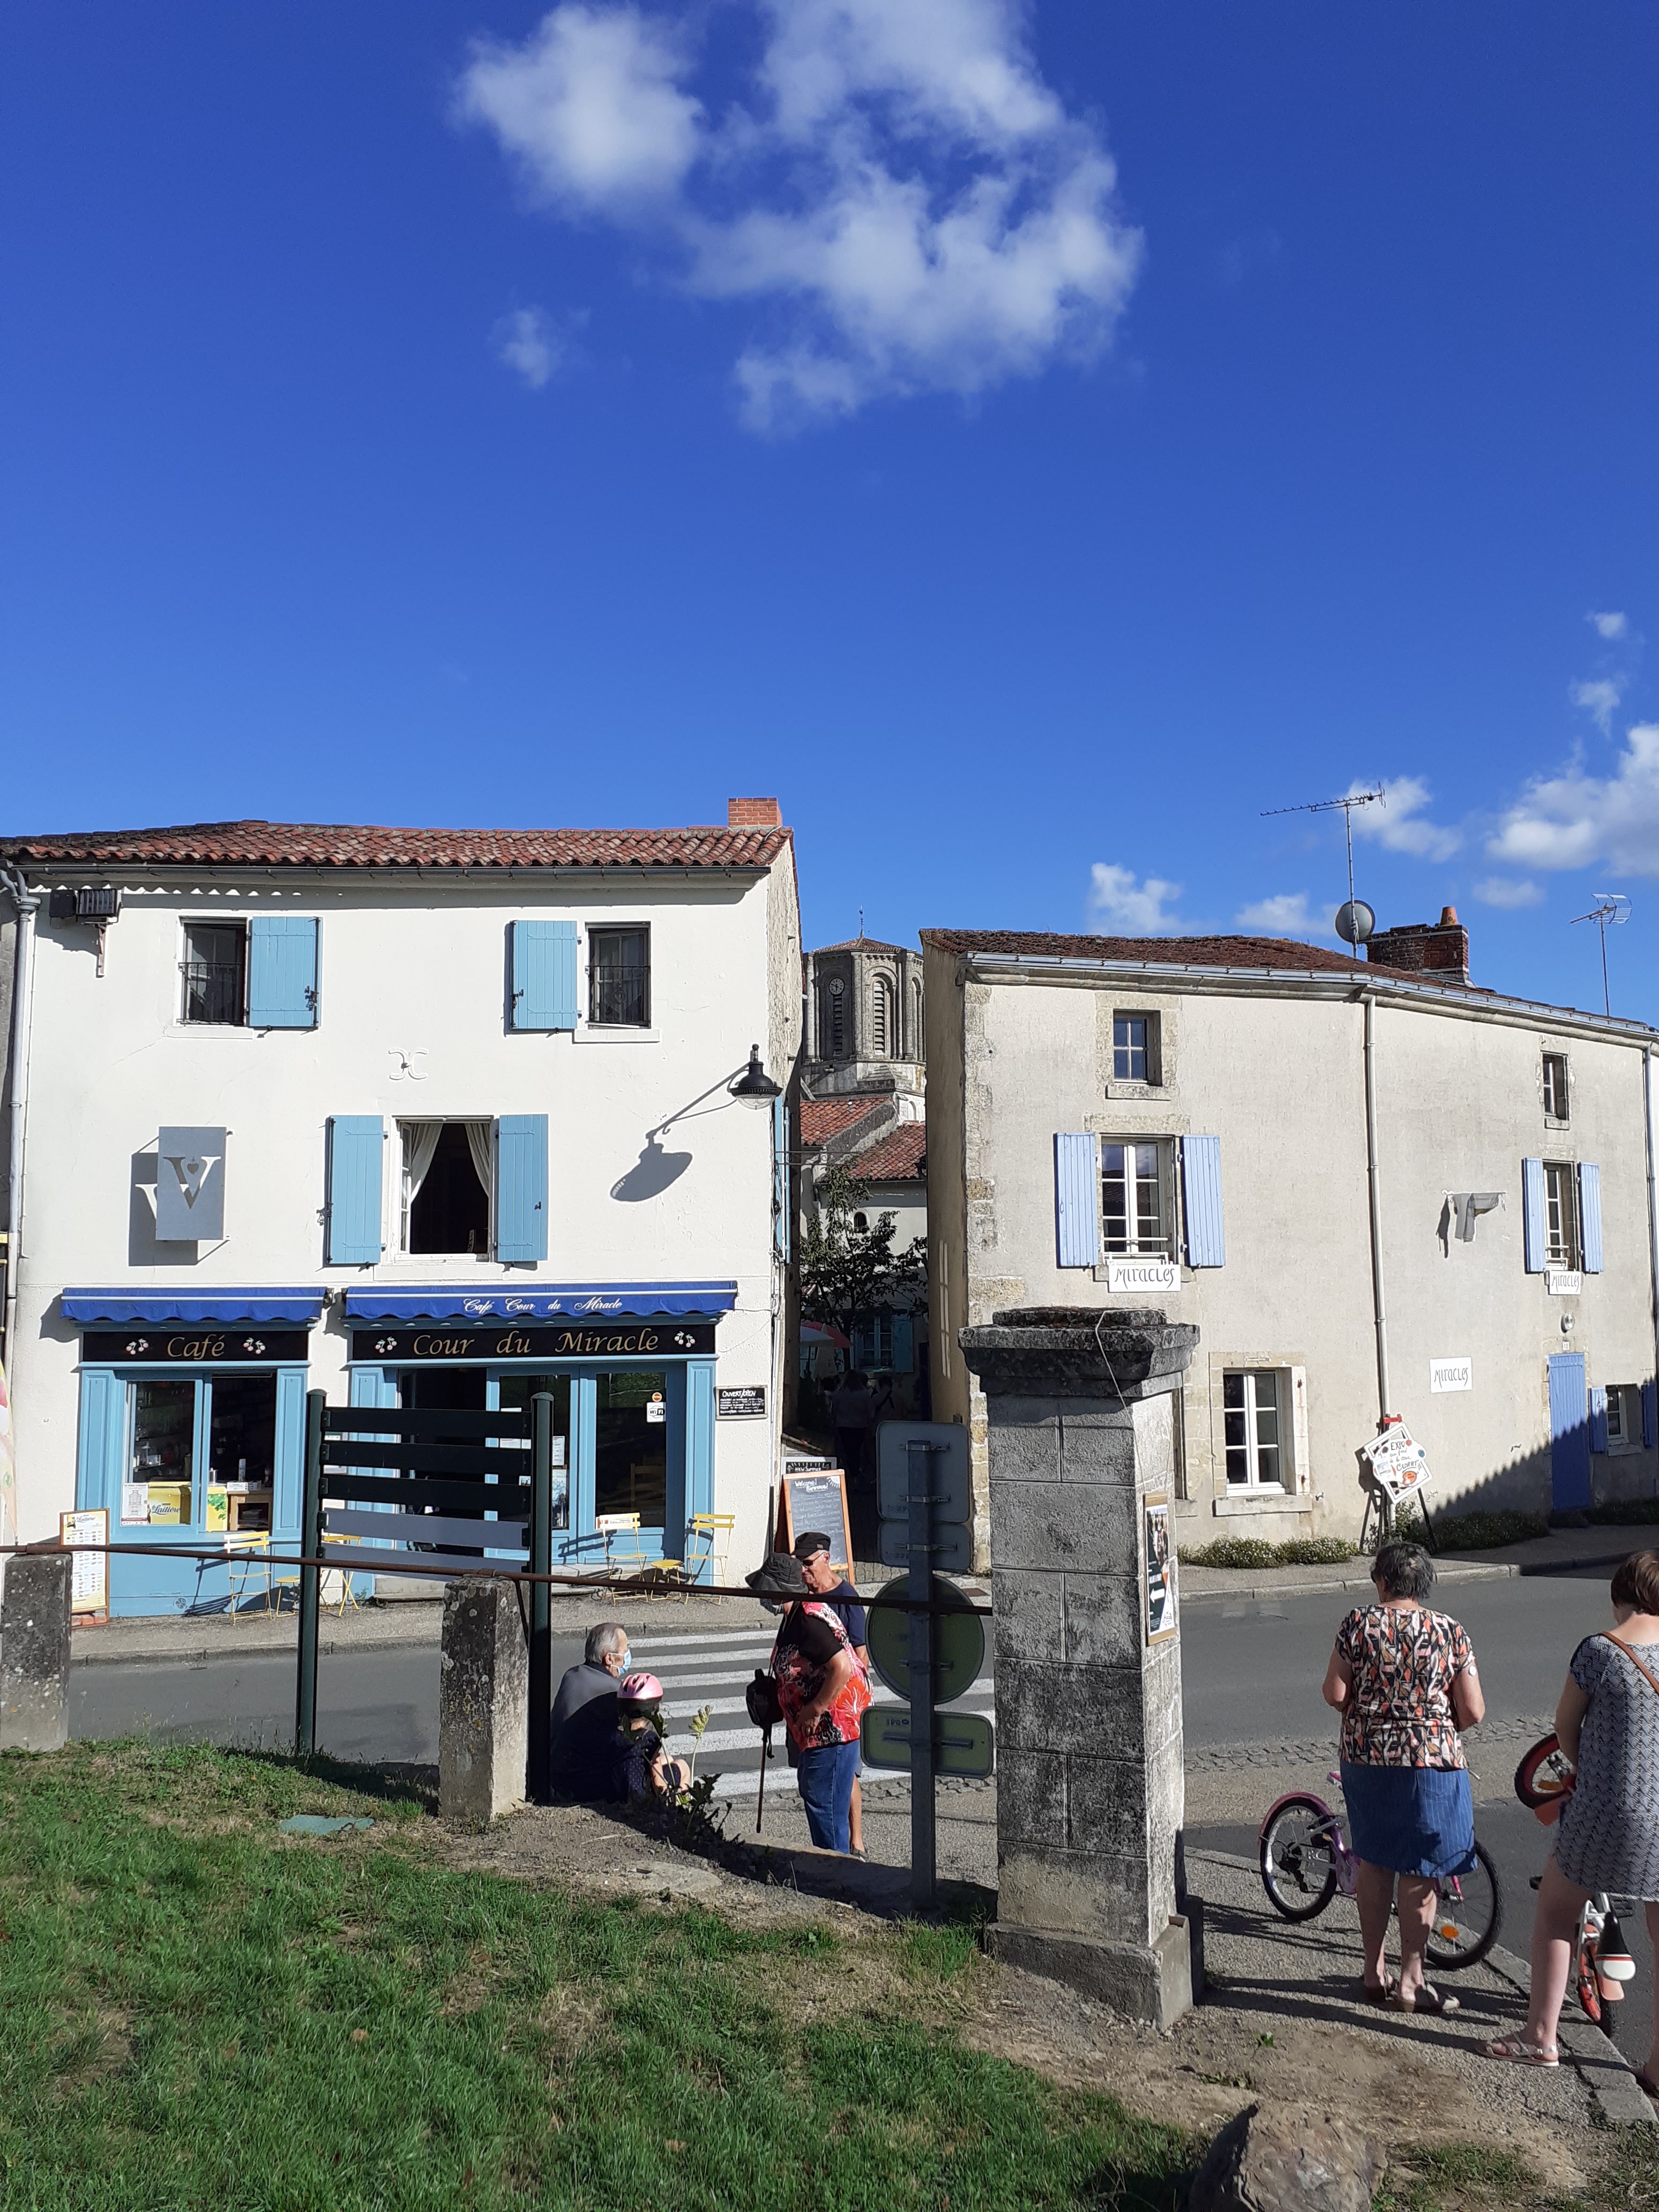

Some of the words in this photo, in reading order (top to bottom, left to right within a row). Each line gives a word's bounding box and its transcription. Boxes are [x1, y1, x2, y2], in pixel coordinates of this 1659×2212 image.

[463, 1298, 495, 1314] Café
[505, 1298, 535, 1312] Cour
[548, 1299, 562, 1310] du
[574, 1297, 623, 1311] Miracle
[167, 1334, 225, 1360] Café
[413, 1334, 475, 1356] Cour
[496, 1331, 532, 1354] du
[554, 1327, 659, 1352] Miracle
[1391, 1441, 1405, 1451] EXPO
